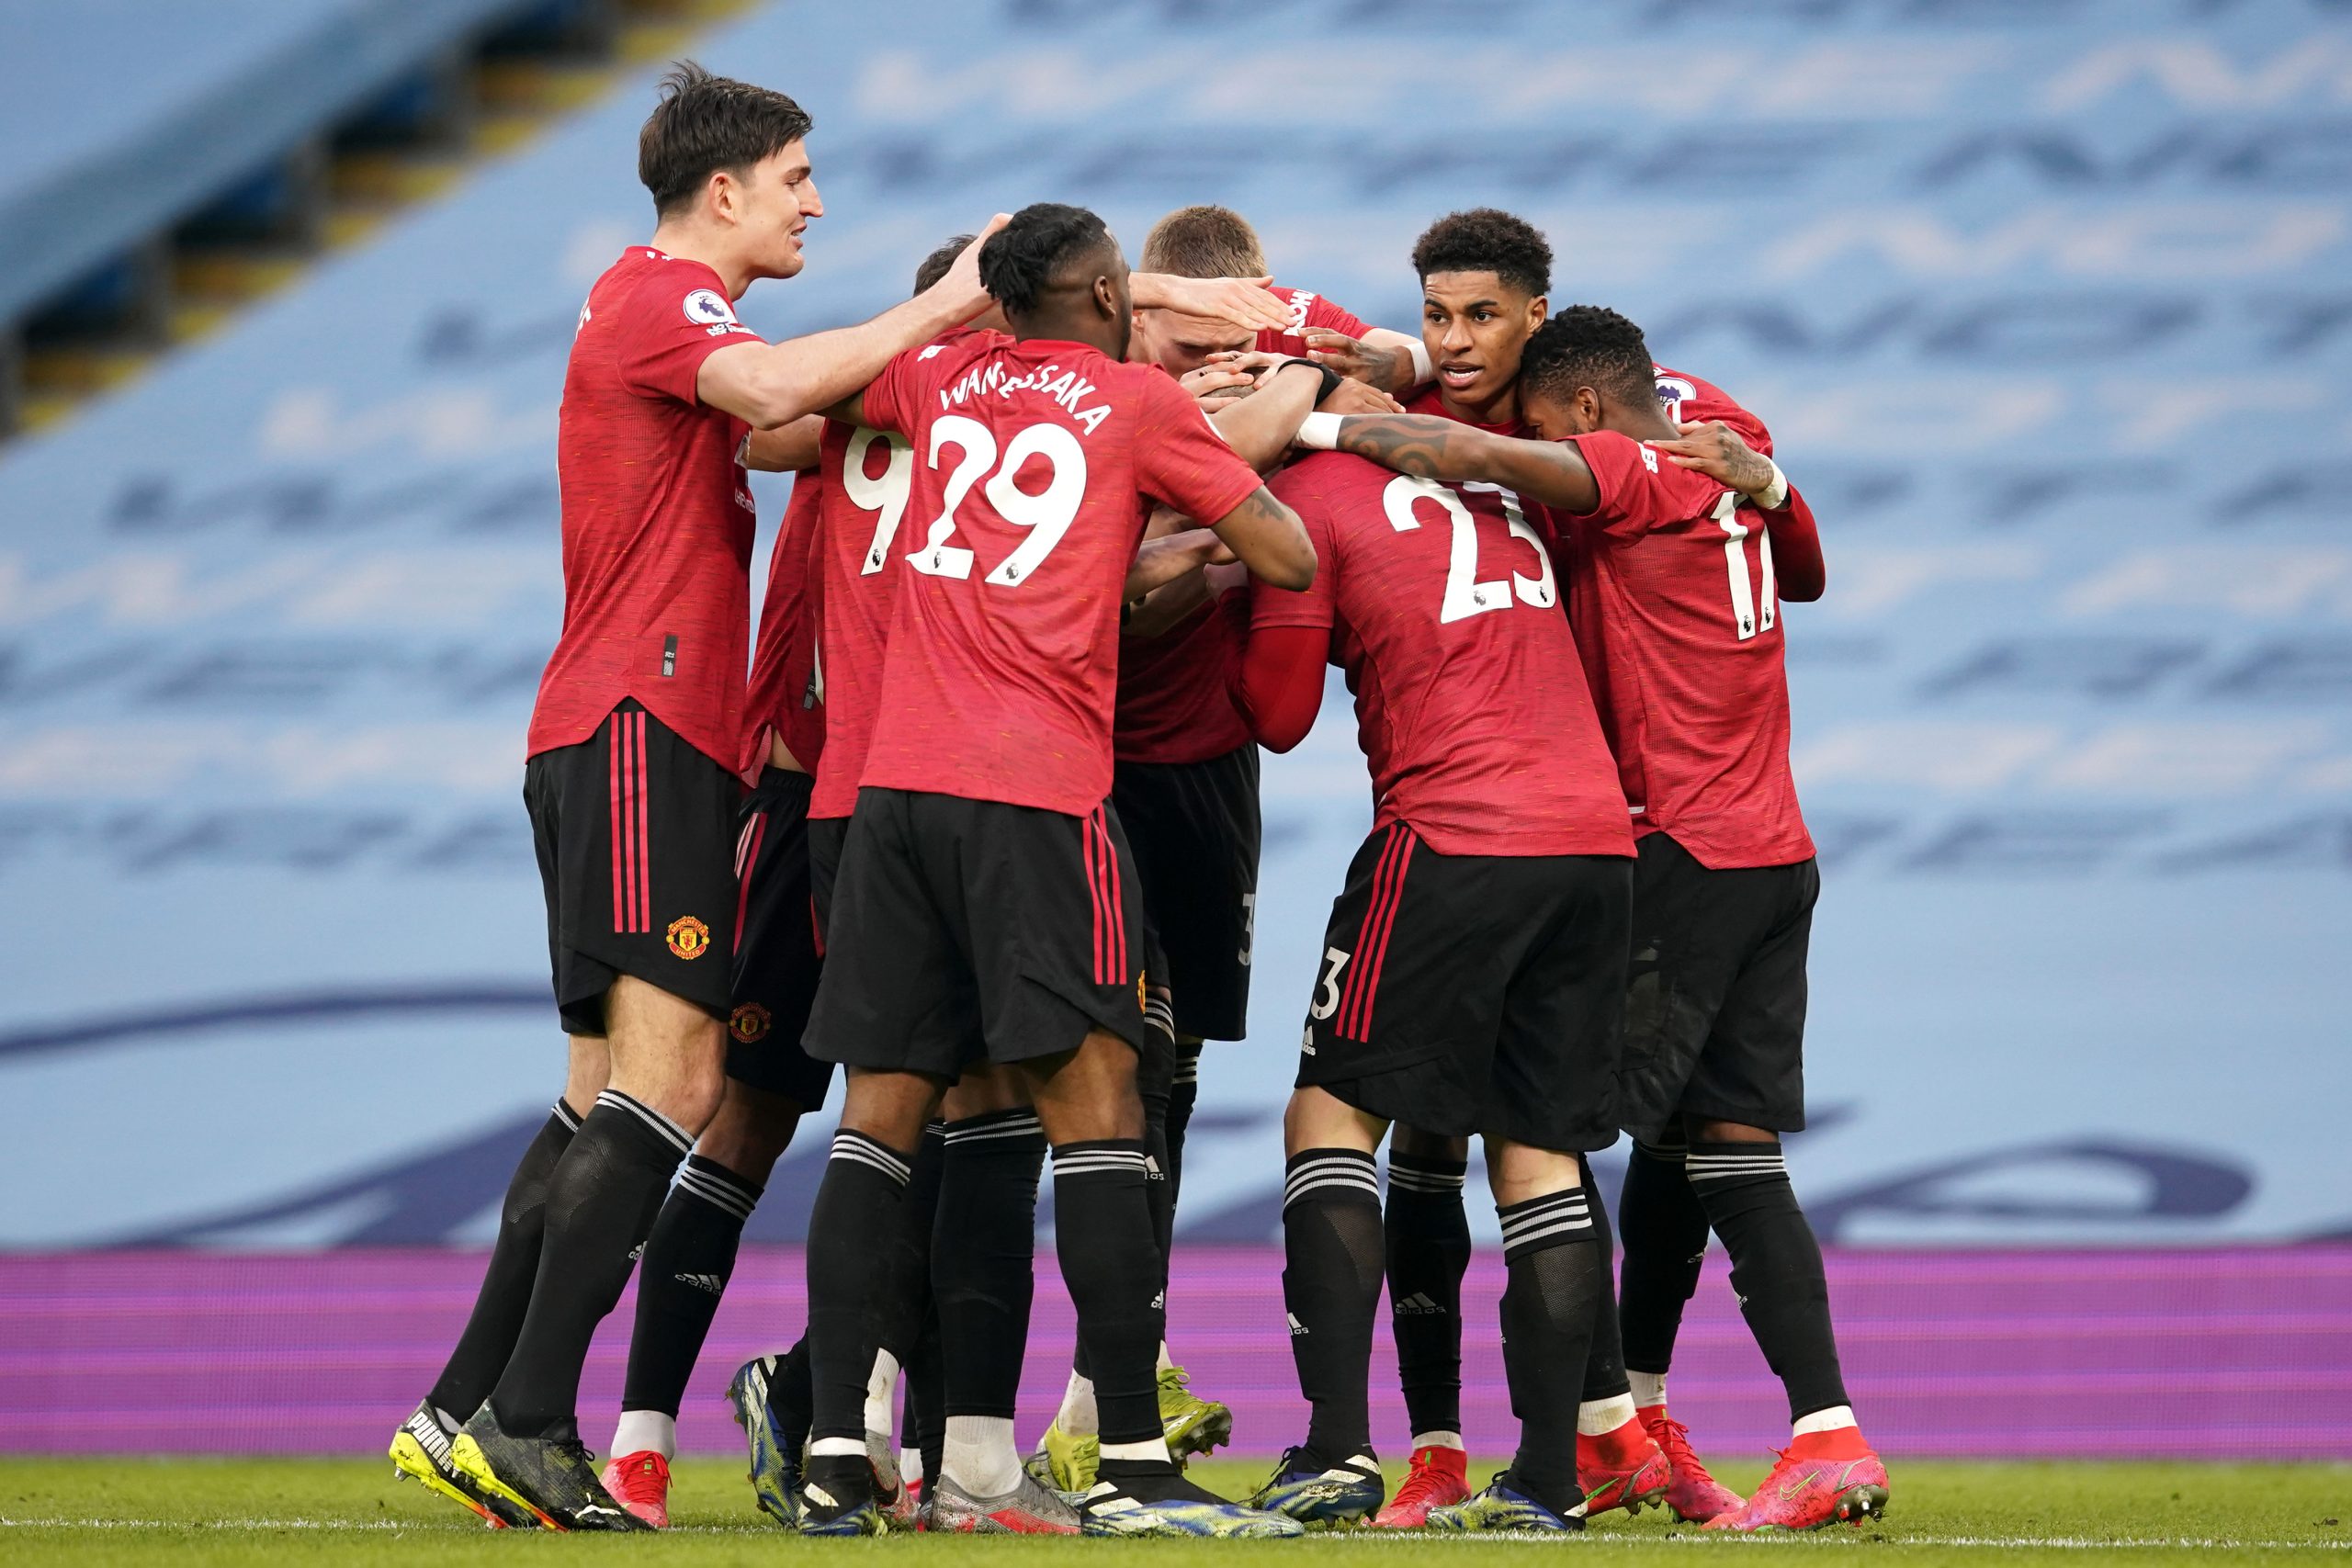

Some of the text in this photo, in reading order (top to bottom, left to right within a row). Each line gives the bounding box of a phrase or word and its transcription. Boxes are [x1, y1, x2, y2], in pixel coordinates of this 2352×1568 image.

[843, 425, 914, 576] 9
[905, 415, 1088, 587] 29
[1383, 474, 1555, 625] 23
[671, 919, 707, 935] MANCHESTER
[675, 949, 700, 957] UNITED
[407, 1411, 454, 1472] PUMA
